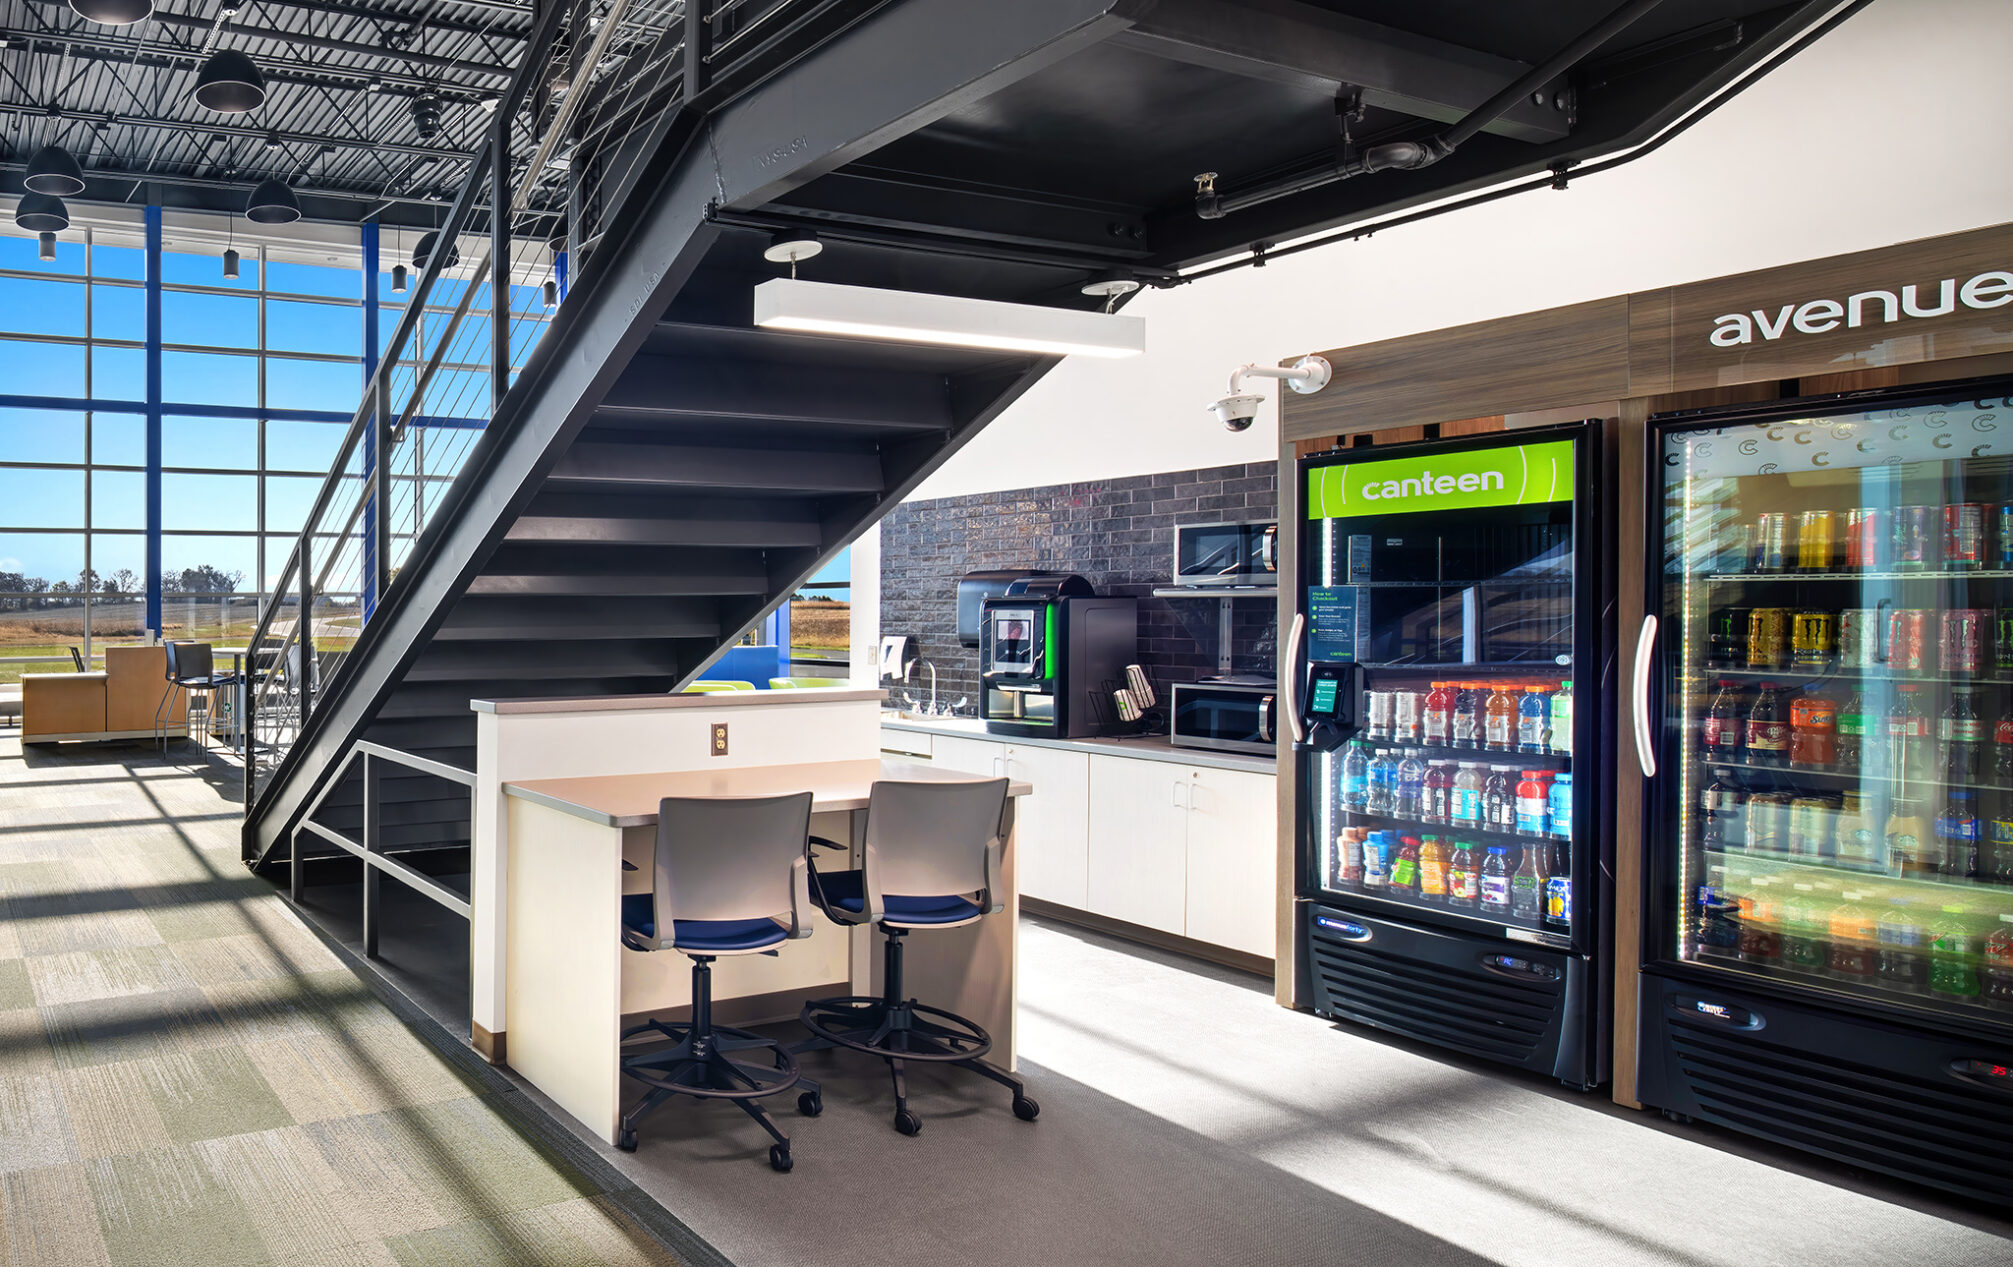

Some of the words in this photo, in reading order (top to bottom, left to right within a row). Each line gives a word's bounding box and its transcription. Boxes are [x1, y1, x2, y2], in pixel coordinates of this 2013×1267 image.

[642, 270, 660, 294] USA
[1709, 271, 2013, 347] avenue
[1362, 471, 1503, 501] canteen
[1992, 1064, 2007, 1076] 35
